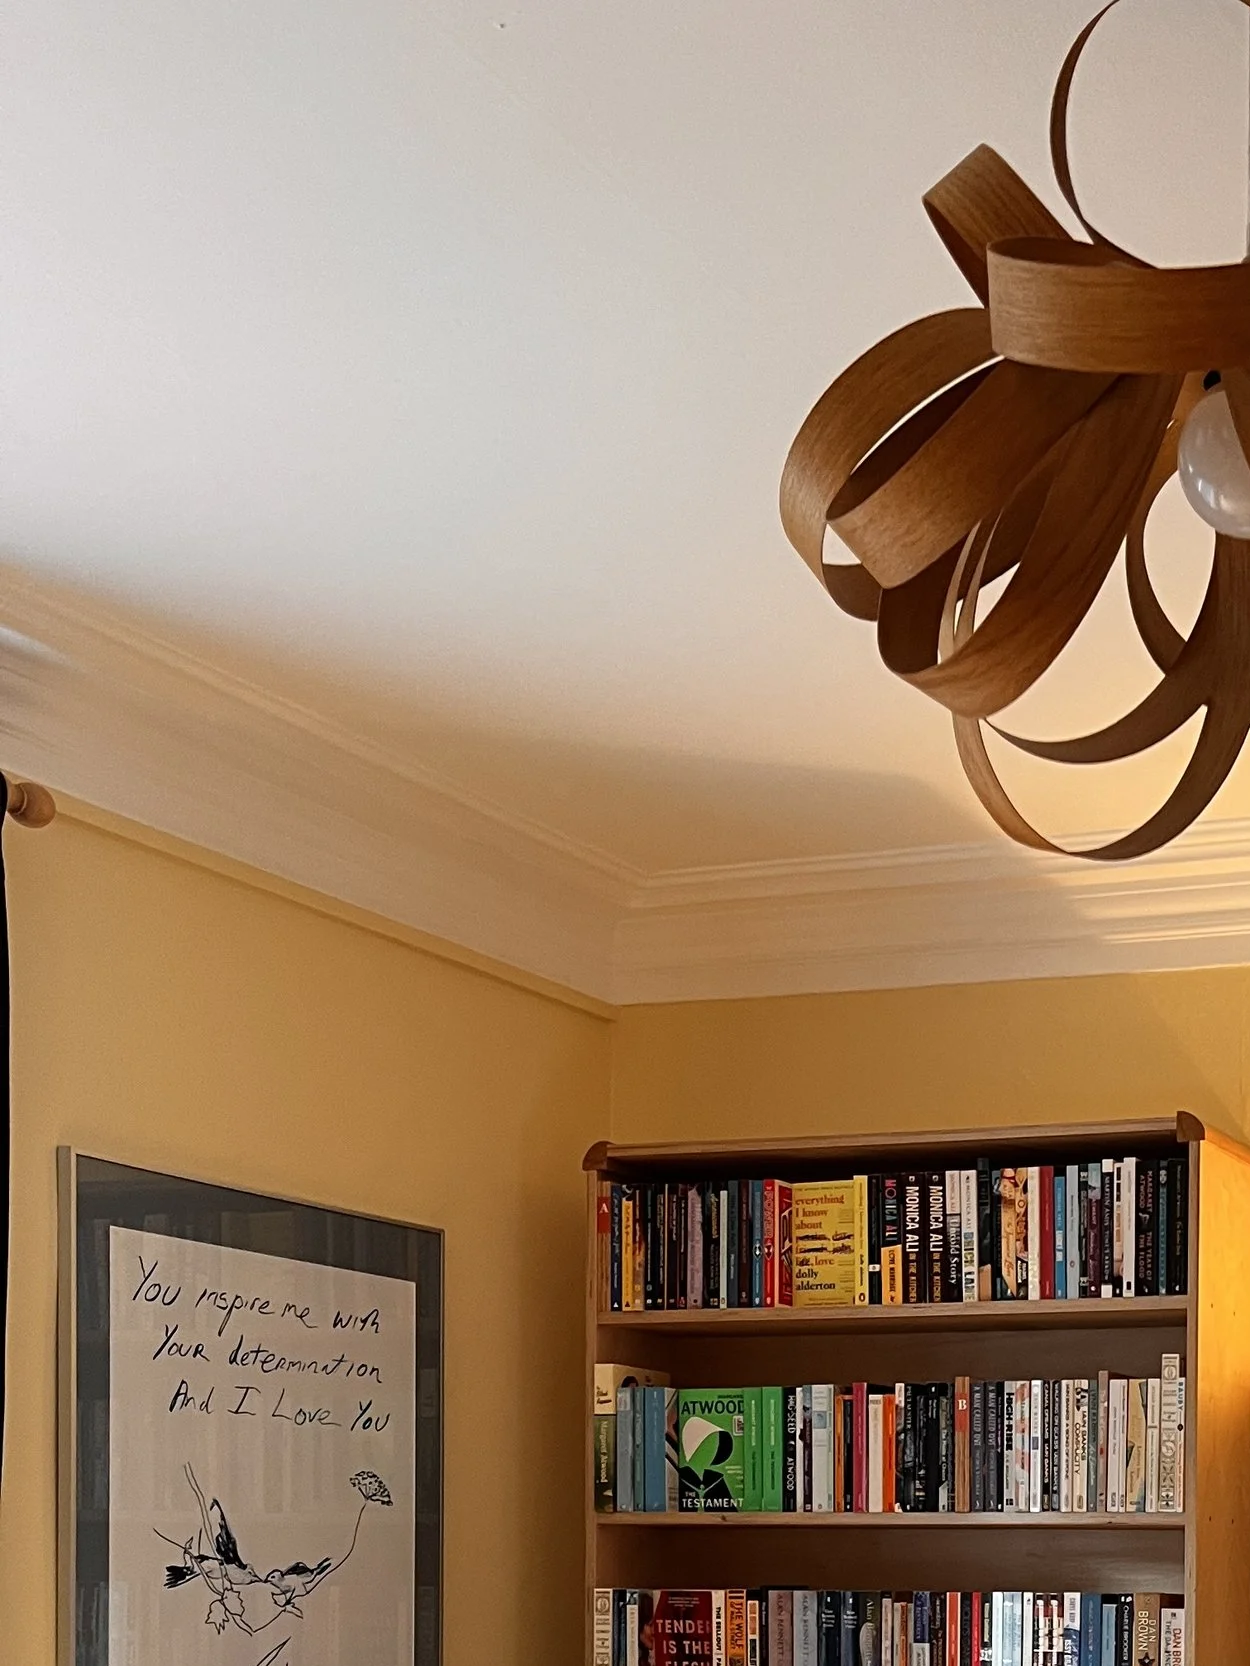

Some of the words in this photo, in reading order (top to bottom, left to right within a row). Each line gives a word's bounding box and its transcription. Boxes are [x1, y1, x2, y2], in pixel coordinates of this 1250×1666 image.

[599, 1202, 609, 1214] A
[795, 1194, 845, 1207] everything
[885, 1180, 897, 1221] MONICA
[906, 1186, 920, 1230] MONICA
[929, 1186, 943, 1230] MONICA
[795, 1221, 823, 1230] about
[885, 1225, 897, 1241] ALI
[949, 1219, 960, 1254] Untold
[906, 1233, 920, 1252] ALI
[929, 1232, 943, 1251] ALI
[964, 1232, 975, 1267] BRICK
[796, 1268, 818, 1279] dolly
[949, 1256, 960, 1284] Story
[133, 1256, 181, 1305] You
[281, 1304, 318, 1328] me
[333, 1308, 380, 1333] with
[796, 1281, 836, 1291] alderton
[964, 1271, 975, 1301] LANE
[169, 1380, 214, 1414] And
[228, 1386, 261, 1416] I
[271, 1388, 342, 1427] Love
[787, 1395, 796, 1434] HAG-SEED
[957, 1399, 968, 1411] B
[1006, 1392, 1015, 1451] HIGH-RISE
[600, 1454, 609, 1483] Atwood
[786, 1457, 795, 1491] ATWOOD
[735, 1602, 744, 1620] THE
[1122, 1605, 1130, 1630] CHARLIE
[735, 1622, 744, 1649] WOLF
[1138, 1610, 1149, 1651] BROWN
[1149, 1619, 1157, 1643] DAN
[1172, 1628, 1182, 1648] DAN
[663, 1640, 677, 1655] IS
[683, 1640, 711, 1655] THE
[1122, 1631, 1130, 1660] BROOKER
